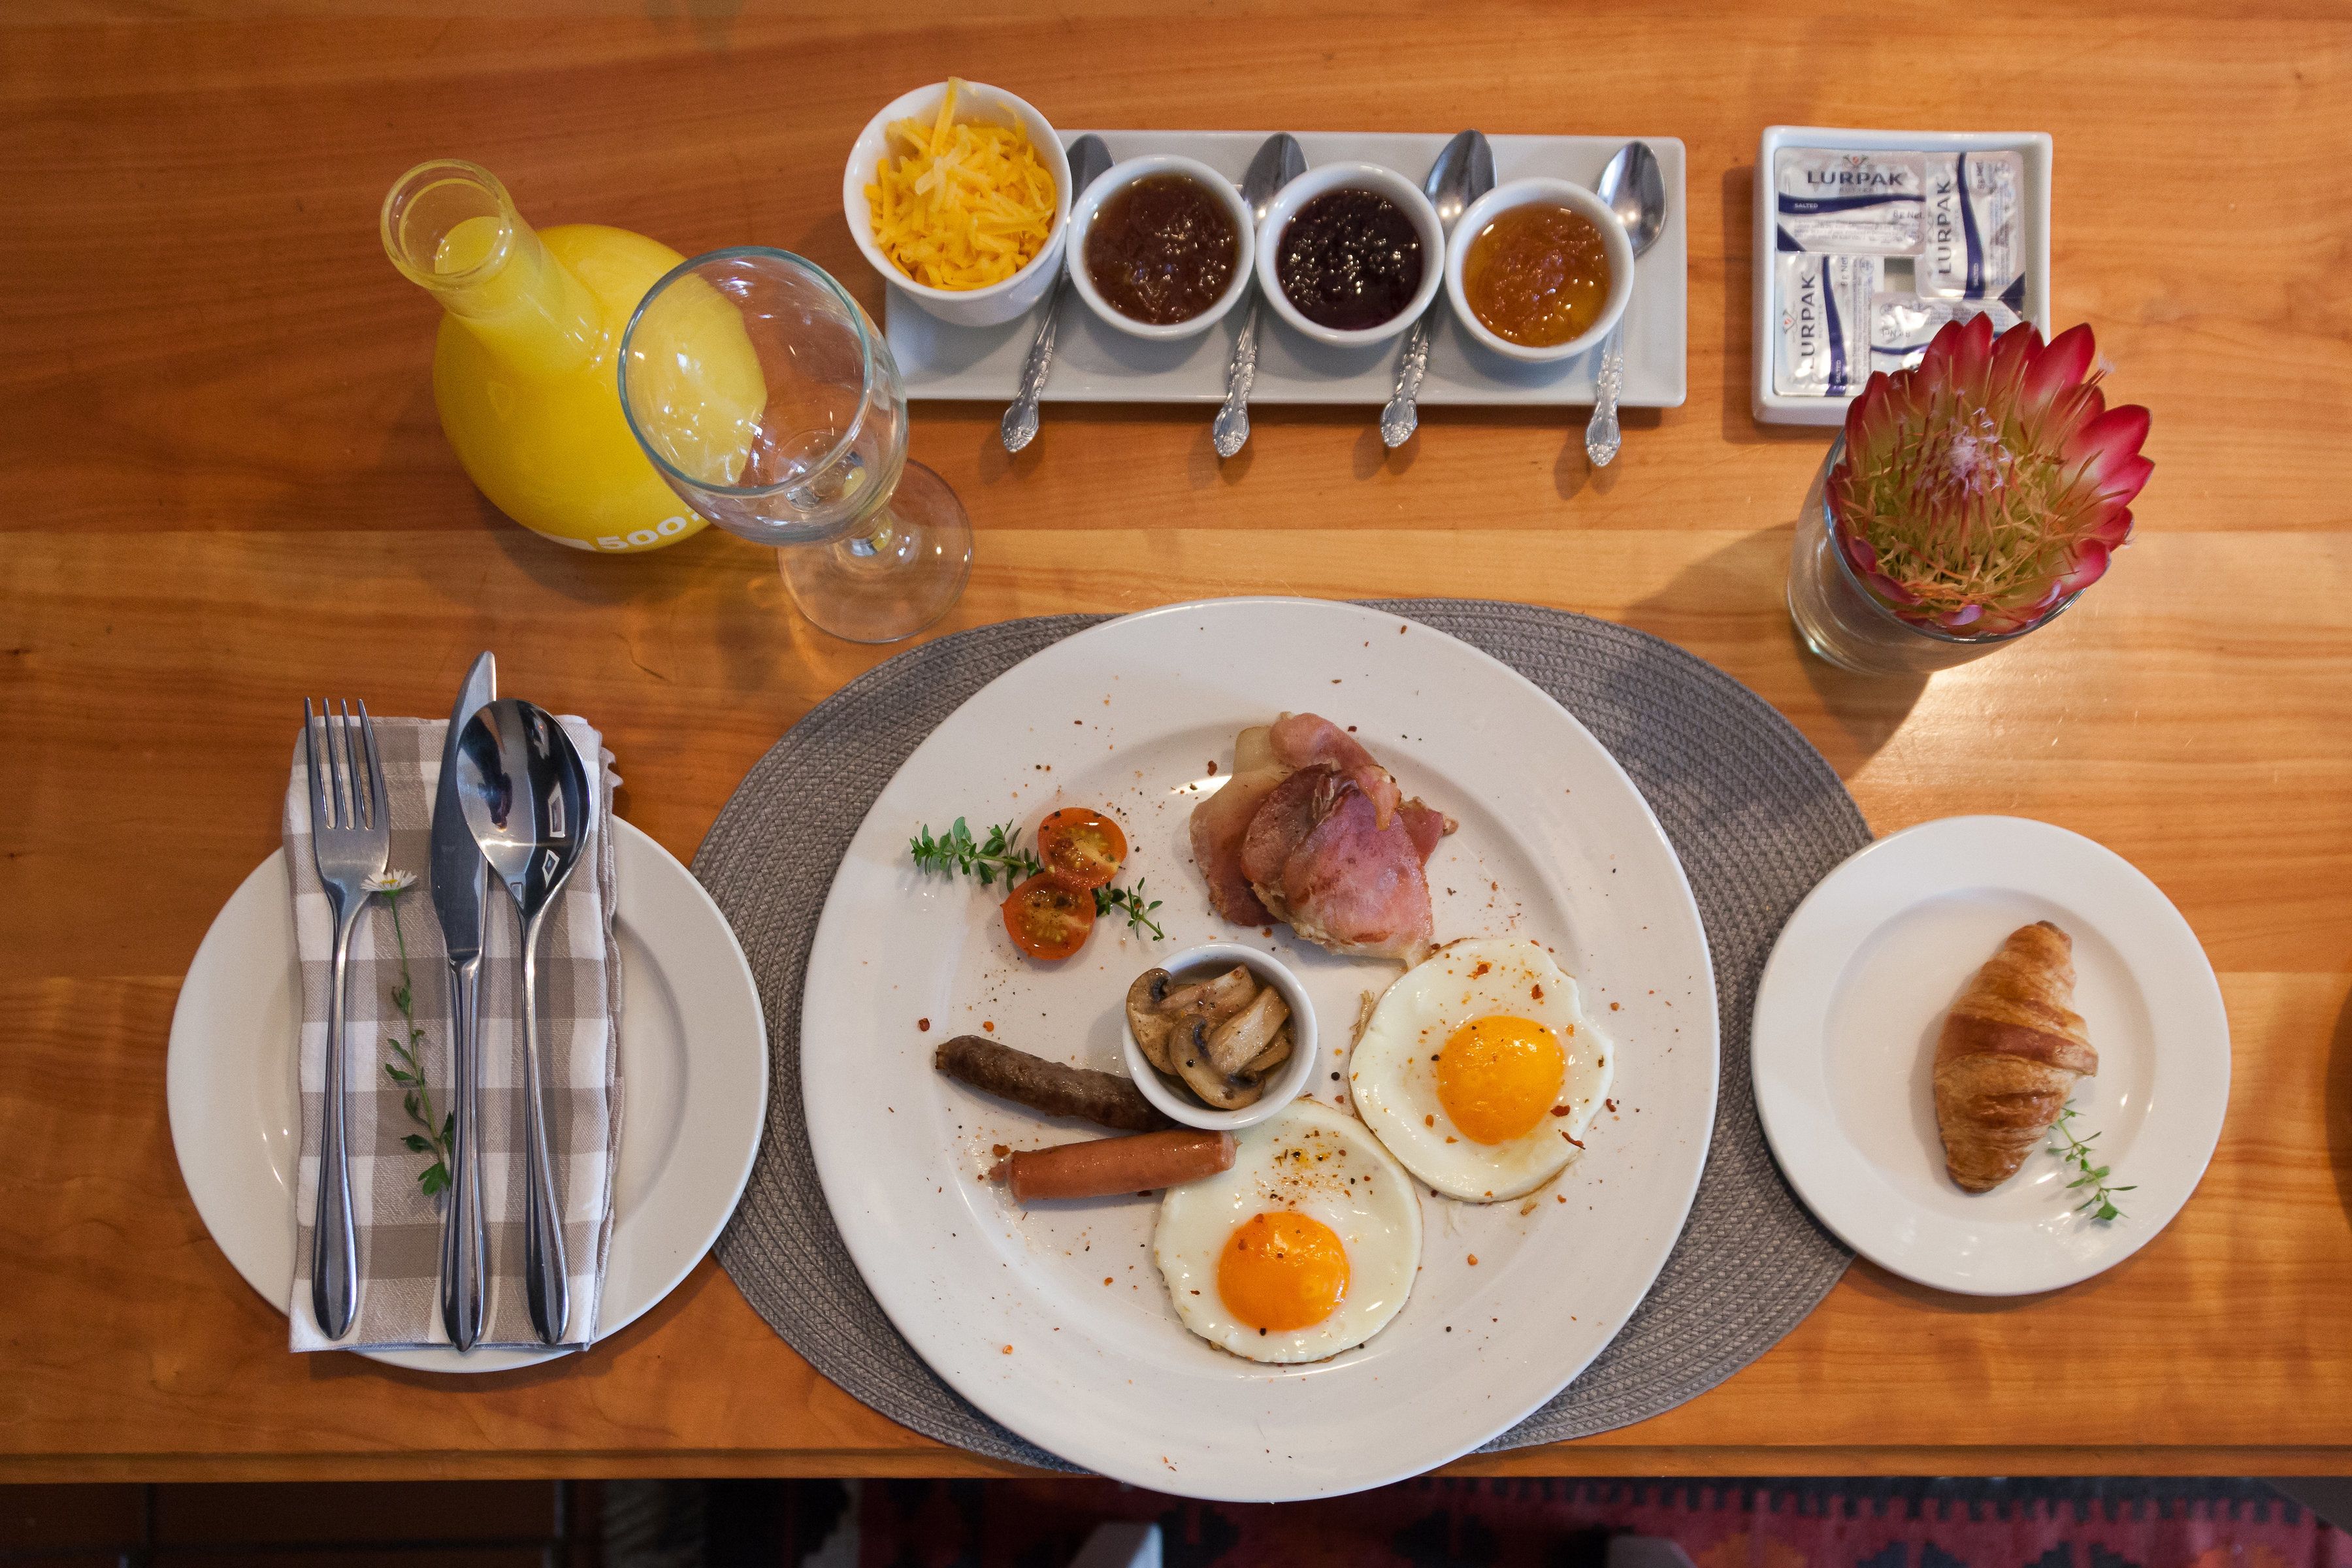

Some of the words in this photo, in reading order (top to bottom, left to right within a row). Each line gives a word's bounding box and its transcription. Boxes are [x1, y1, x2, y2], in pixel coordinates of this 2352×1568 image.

[1807, 170, 1903, 186] LURPAK
[1936, 180, 1952, 274] LURPAK
[596, 516, 687, 550] 500
